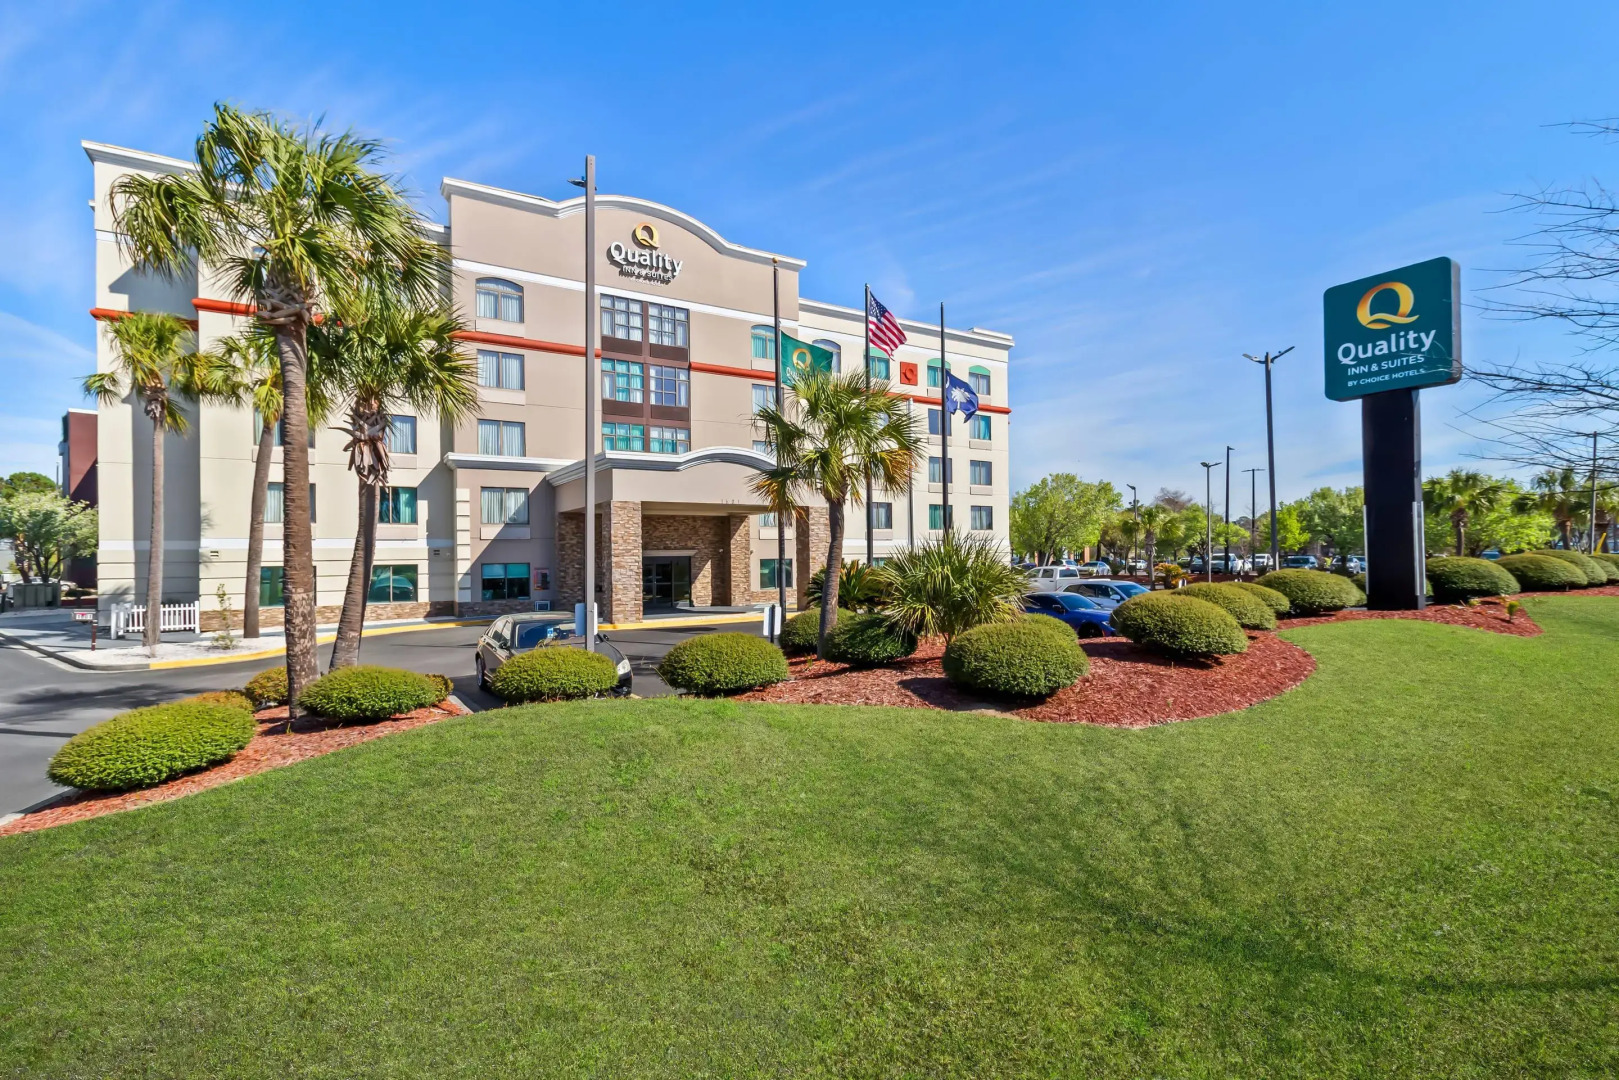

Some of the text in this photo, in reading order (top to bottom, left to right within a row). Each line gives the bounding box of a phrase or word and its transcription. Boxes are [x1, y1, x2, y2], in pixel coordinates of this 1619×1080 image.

[610, 241, 683, 275] Quality
[622, 265, 637, 275] INN
[647, 270, 672, 281] SUITES
[1356, 281, 1420, 330] Q
[1337, 329, 1436, 365] Quality
[1347, 354, 1425, 376] INN & SUITES
[1359, 374, 1390, 385] CHOICE
[1391, 368, 1426, 379] HOTELS
